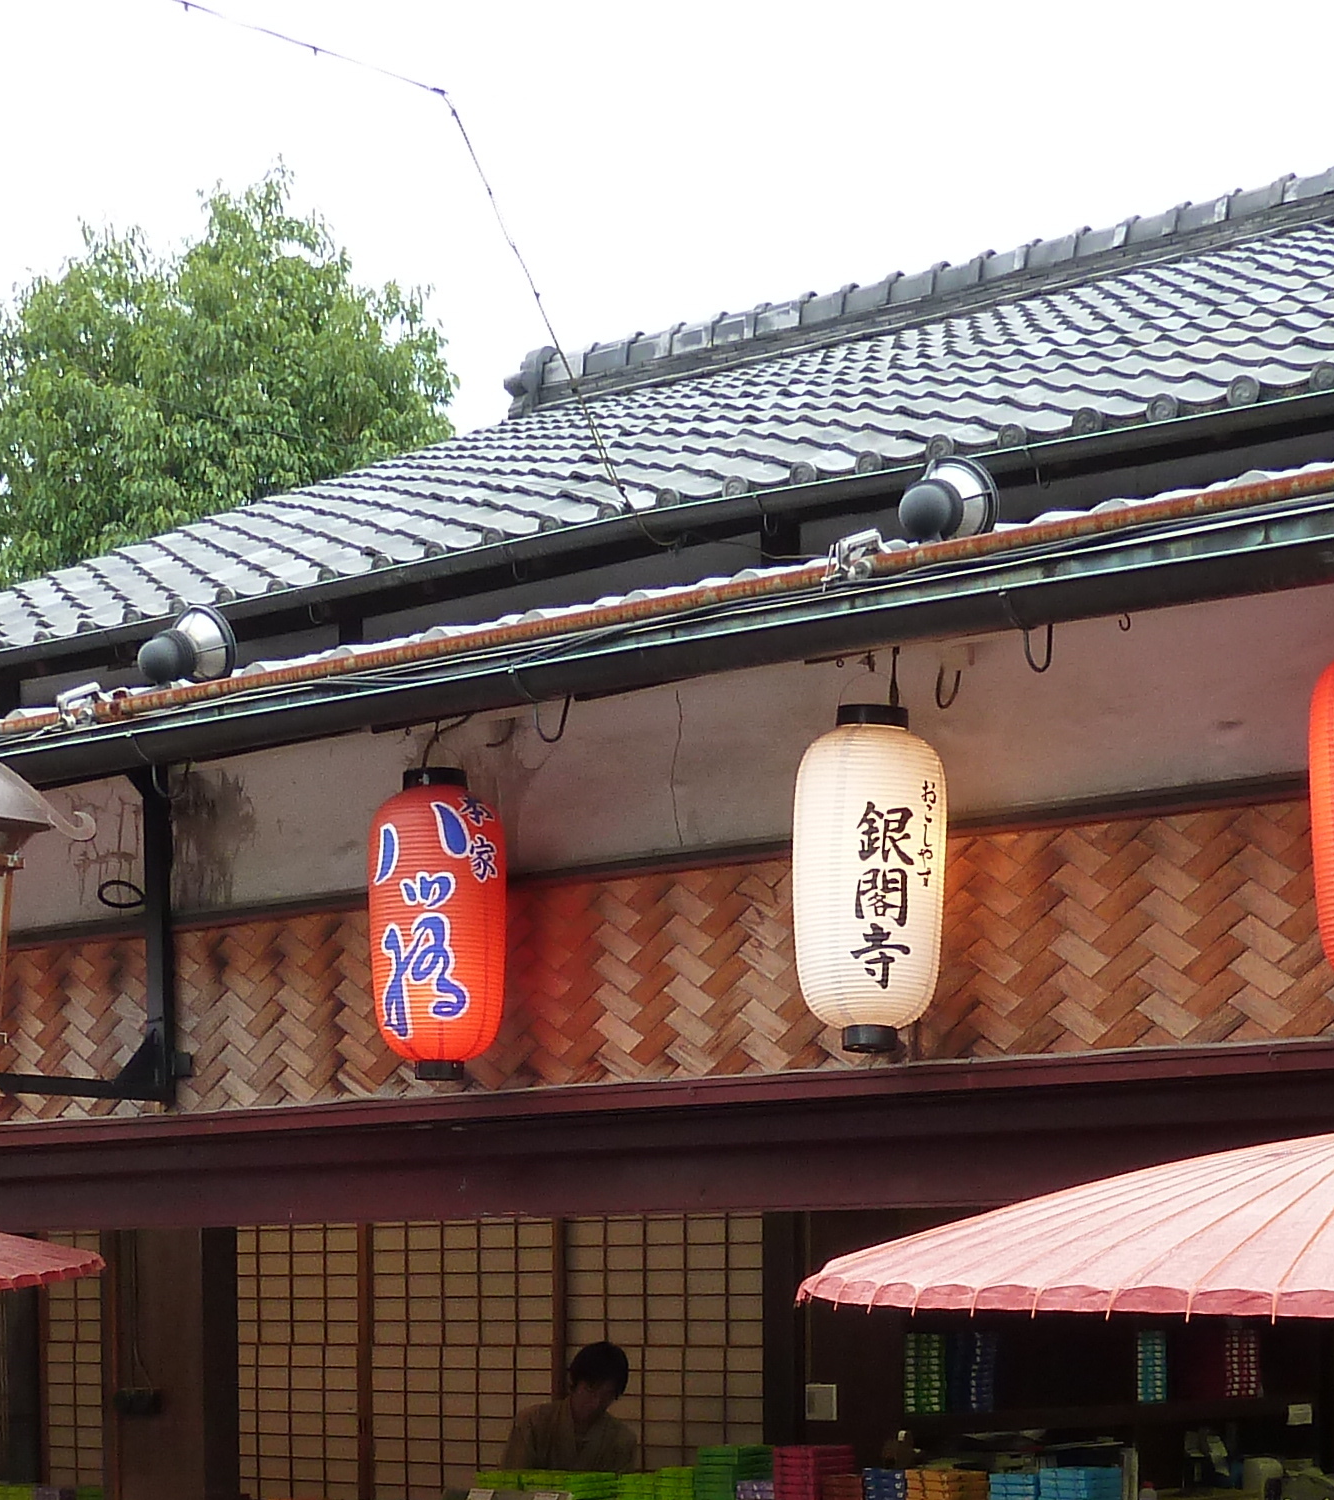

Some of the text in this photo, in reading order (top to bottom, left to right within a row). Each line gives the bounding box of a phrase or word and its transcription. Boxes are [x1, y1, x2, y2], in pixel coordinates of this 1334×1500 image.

[458, 796, 499, 882] 本家
[849, 800, 915, 989] 銀閣寺
